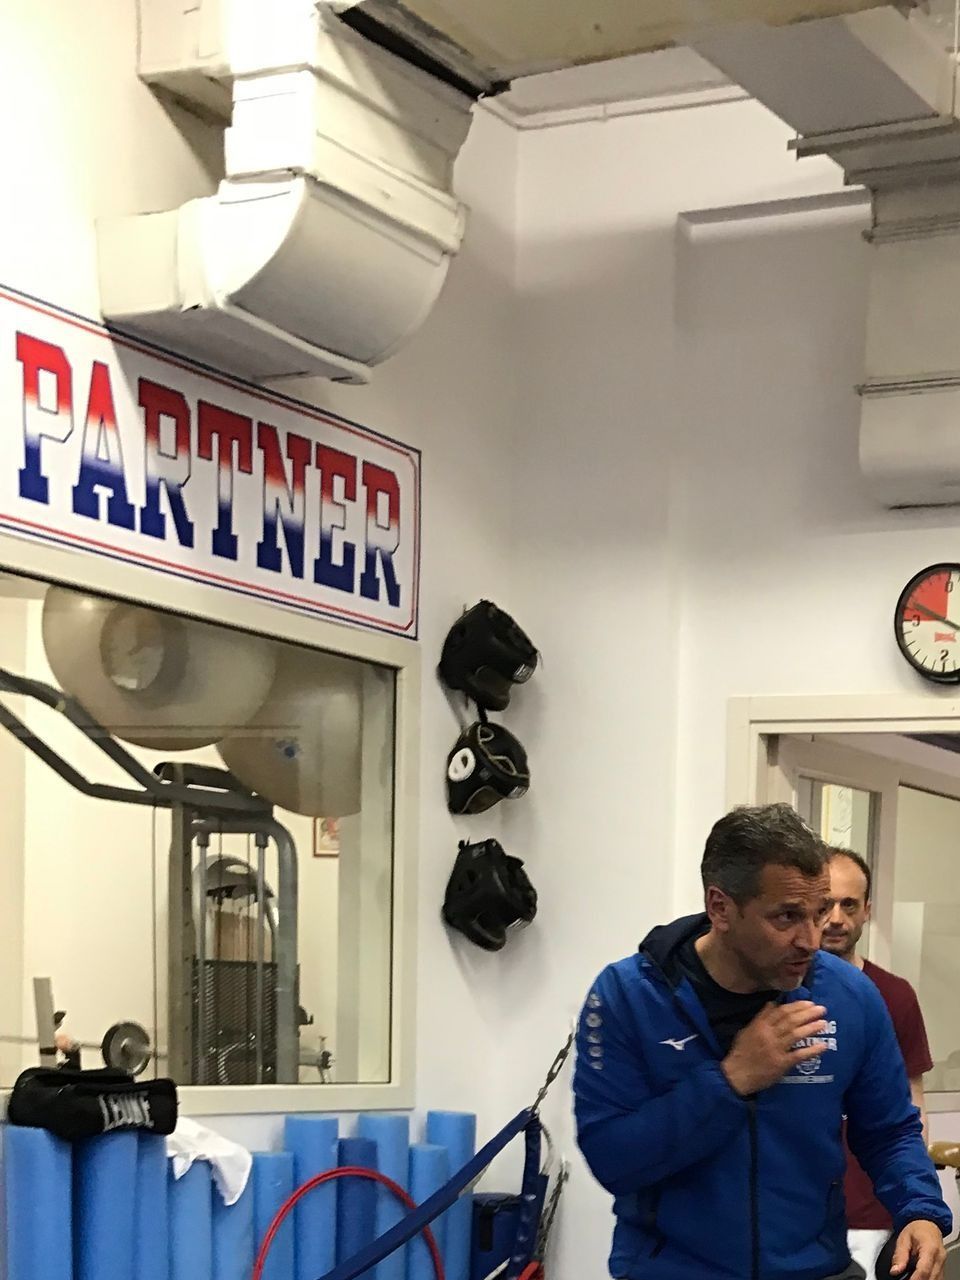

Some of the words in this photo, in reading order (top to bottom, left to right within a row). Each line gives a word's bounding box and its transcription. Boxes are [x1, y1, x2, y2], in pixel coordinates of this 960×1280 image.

[16, 331, 401, 608] PARTNER
[912, 614, 921, 627] 3
[940, 649, 949, 661] 2
